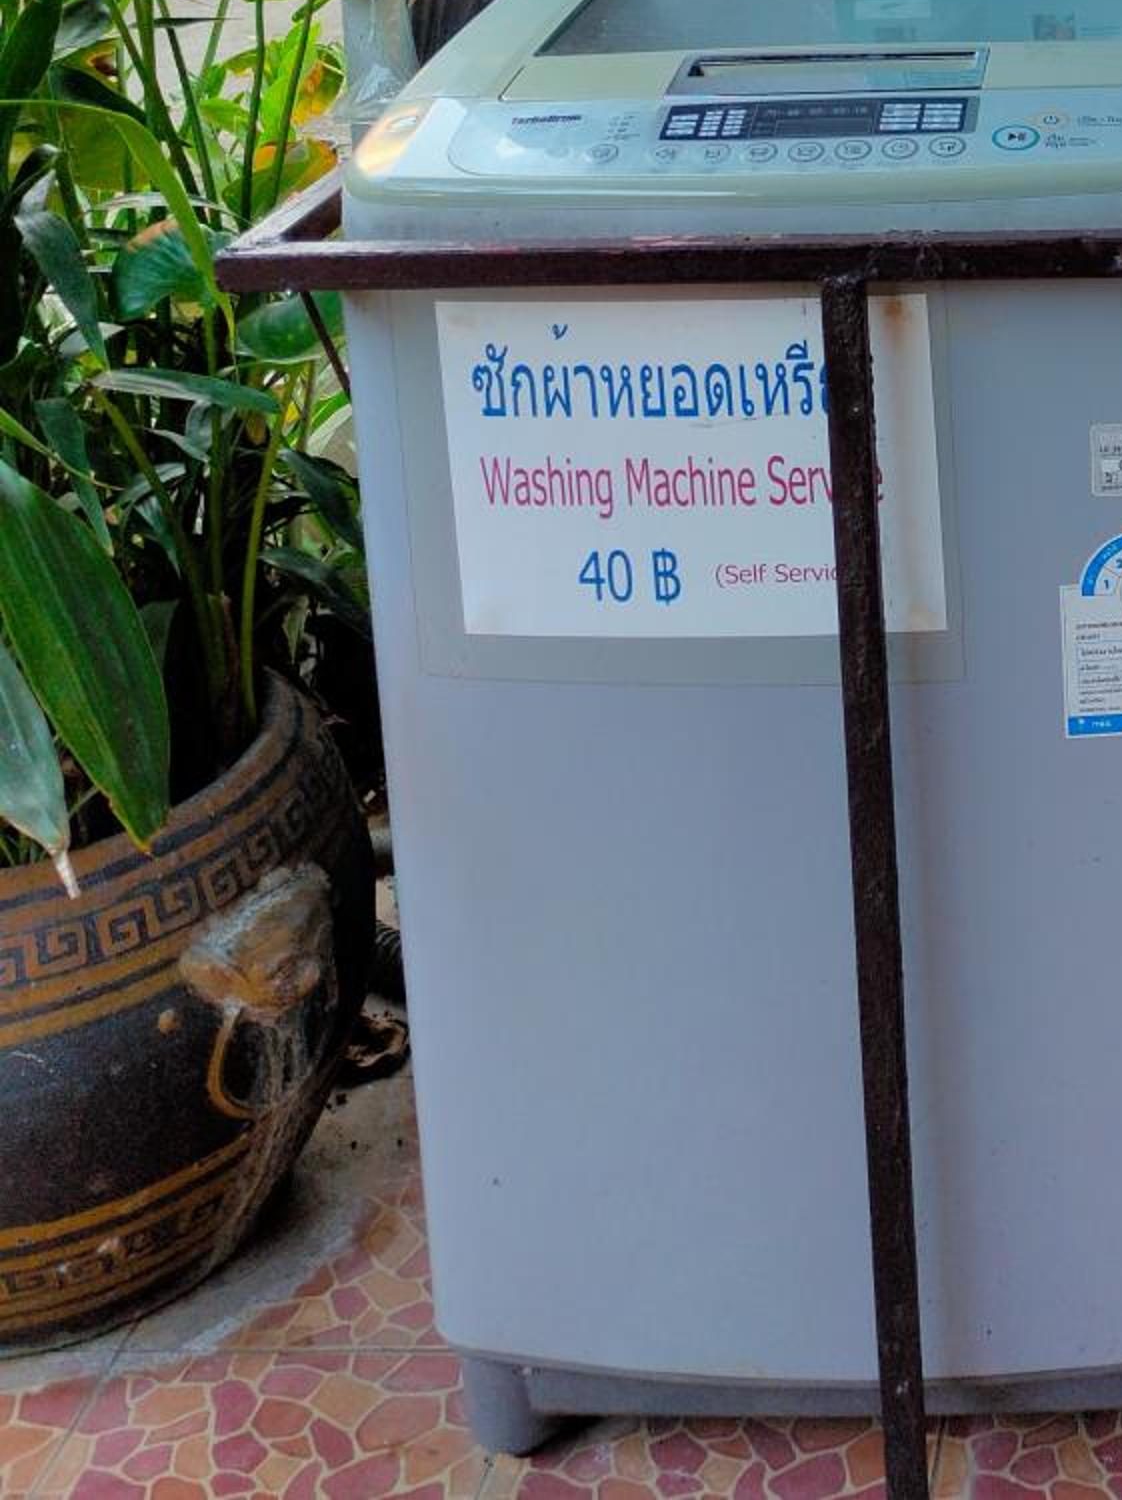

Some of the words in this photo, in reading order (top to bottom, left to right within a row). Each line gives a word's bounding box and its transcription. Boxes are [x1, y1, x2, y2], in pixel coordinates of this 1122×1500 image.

[471, 323, 830, 420] ซักผ้าหยอดเหรี
[480, 457, 613, 519] Washing
[625, 456, 757, 507] Machine
[767, 455, 884, 506] Serve
[578, 549, 634, 602] 40
[714, 562, 768, 588] (Self
[774, 562, 838, 583] Servic
